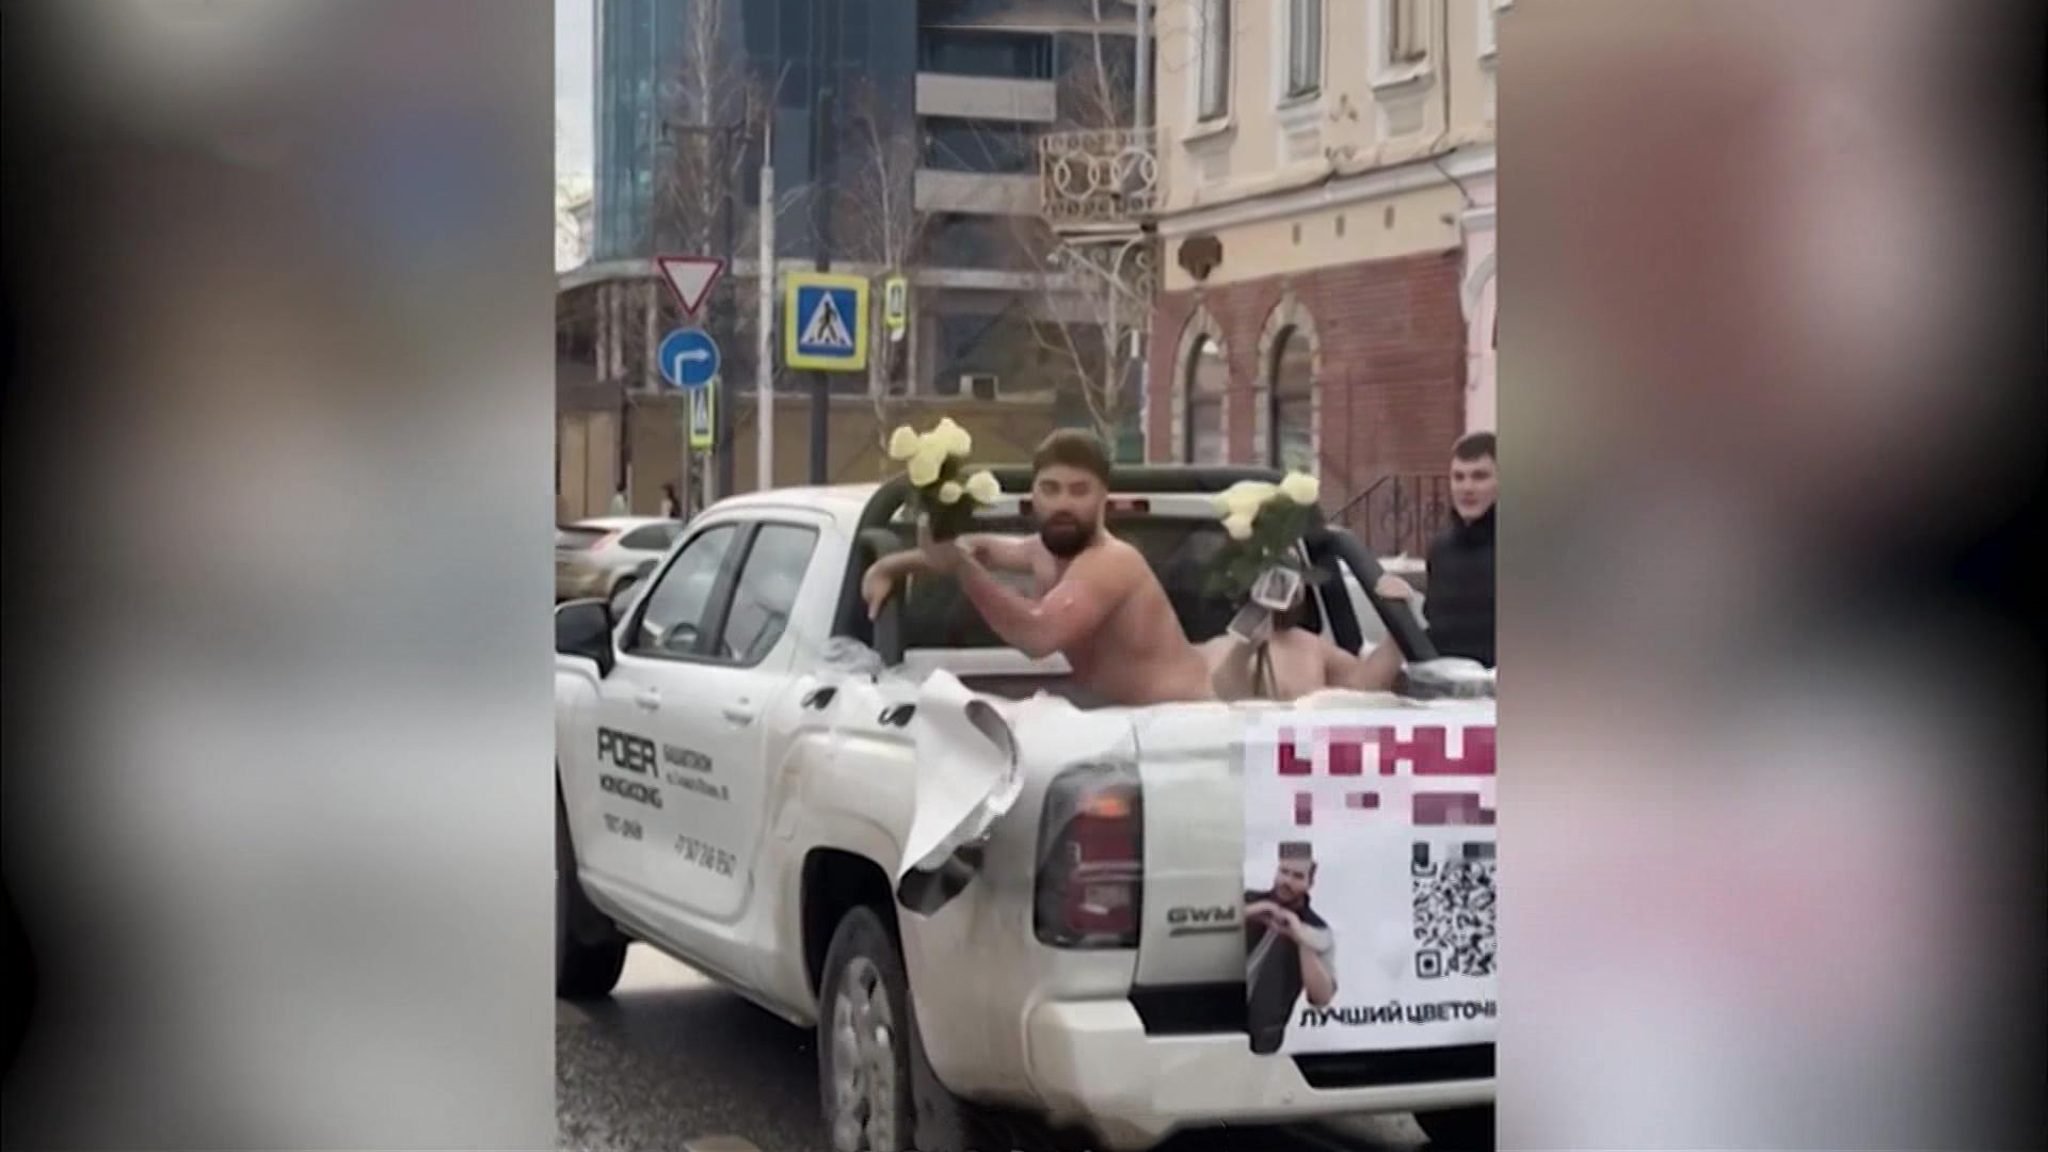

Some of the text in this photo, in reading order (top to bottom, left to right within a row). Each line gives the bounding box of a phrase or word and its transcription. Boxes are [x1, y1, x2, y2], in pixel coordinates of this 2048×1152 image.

[597, 727, 658, 778] POER
[1167, 906, 1235, 923] GWM
[1299, 1000, 1402, 1027] ЛУЧШИЙ
